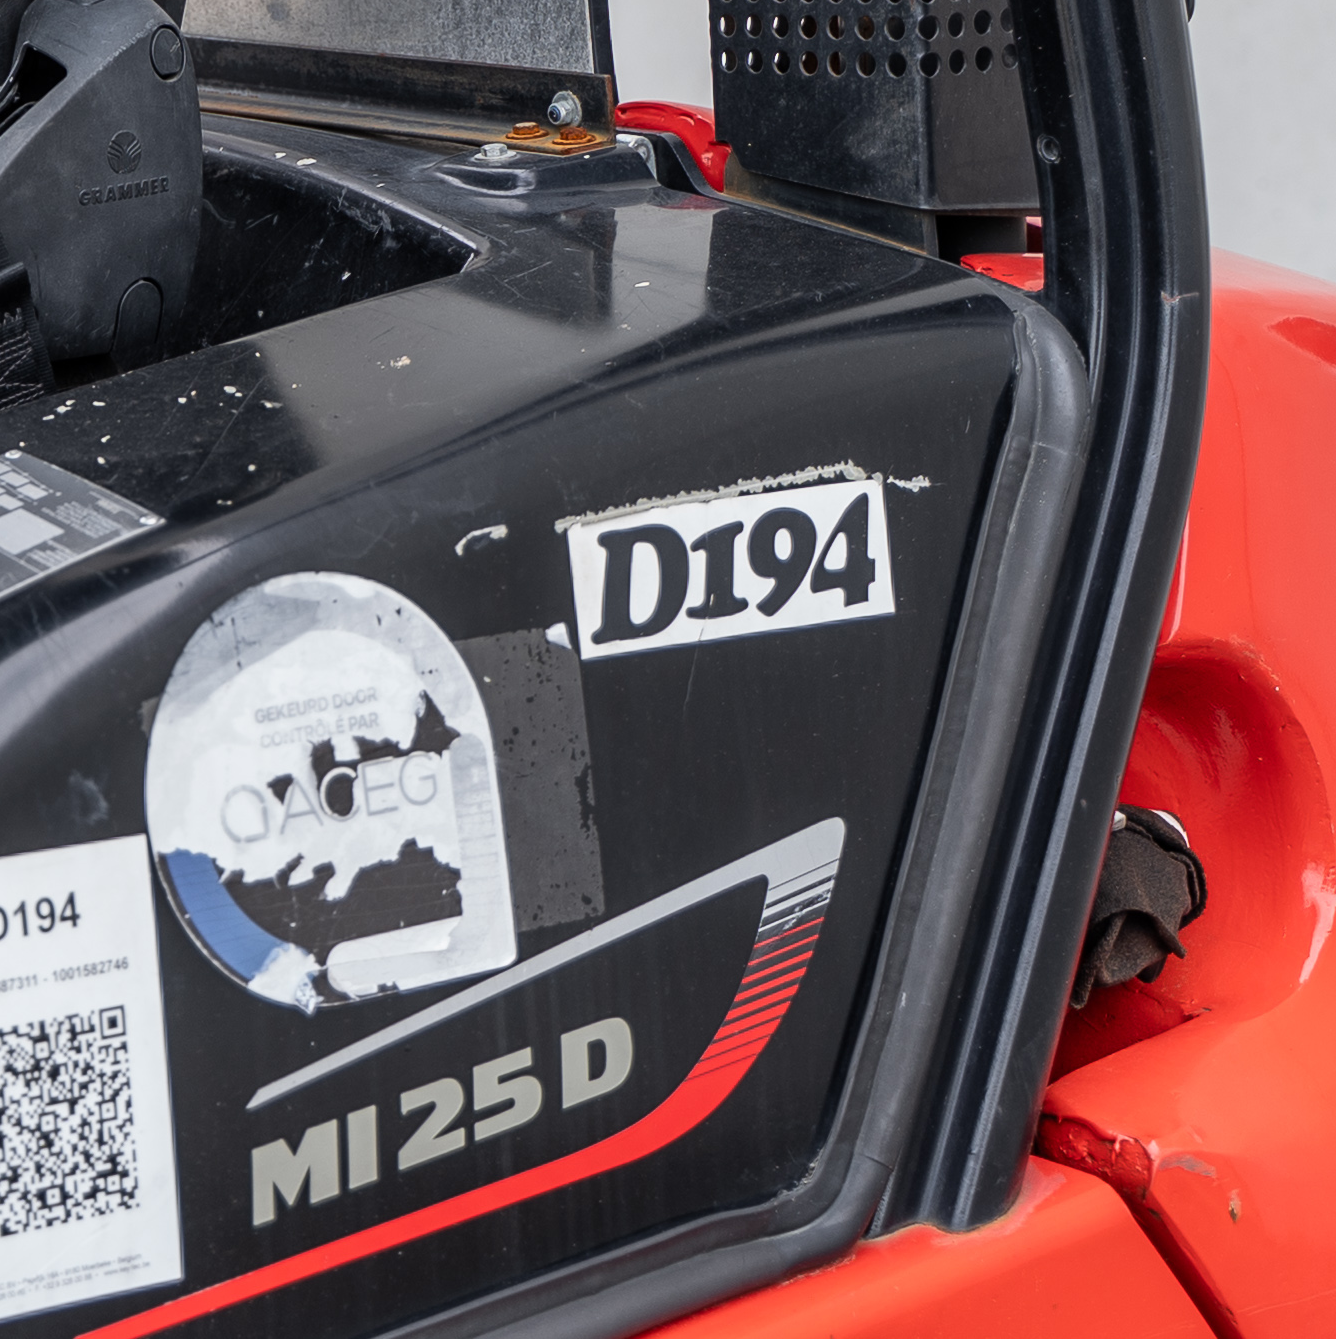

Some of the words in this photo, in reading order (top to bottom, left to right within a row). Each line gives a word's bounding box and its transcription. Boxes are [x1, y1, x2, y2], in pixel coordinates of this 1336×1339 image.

[78, 176, 169, 207] GRAMMER
[591, 492, 876, 645] D194
[254, 696, 329, 724] GEKEURD
[332, 687, 377, 709] DOOR
[348, 712, 379, 732] PAR
[52, 956, 129, 983] 1001582746
[251, 1104, 380, 1227] MI
[397, 1046, 543, 1171] 25
[560, 1017, 634, 1110] D
